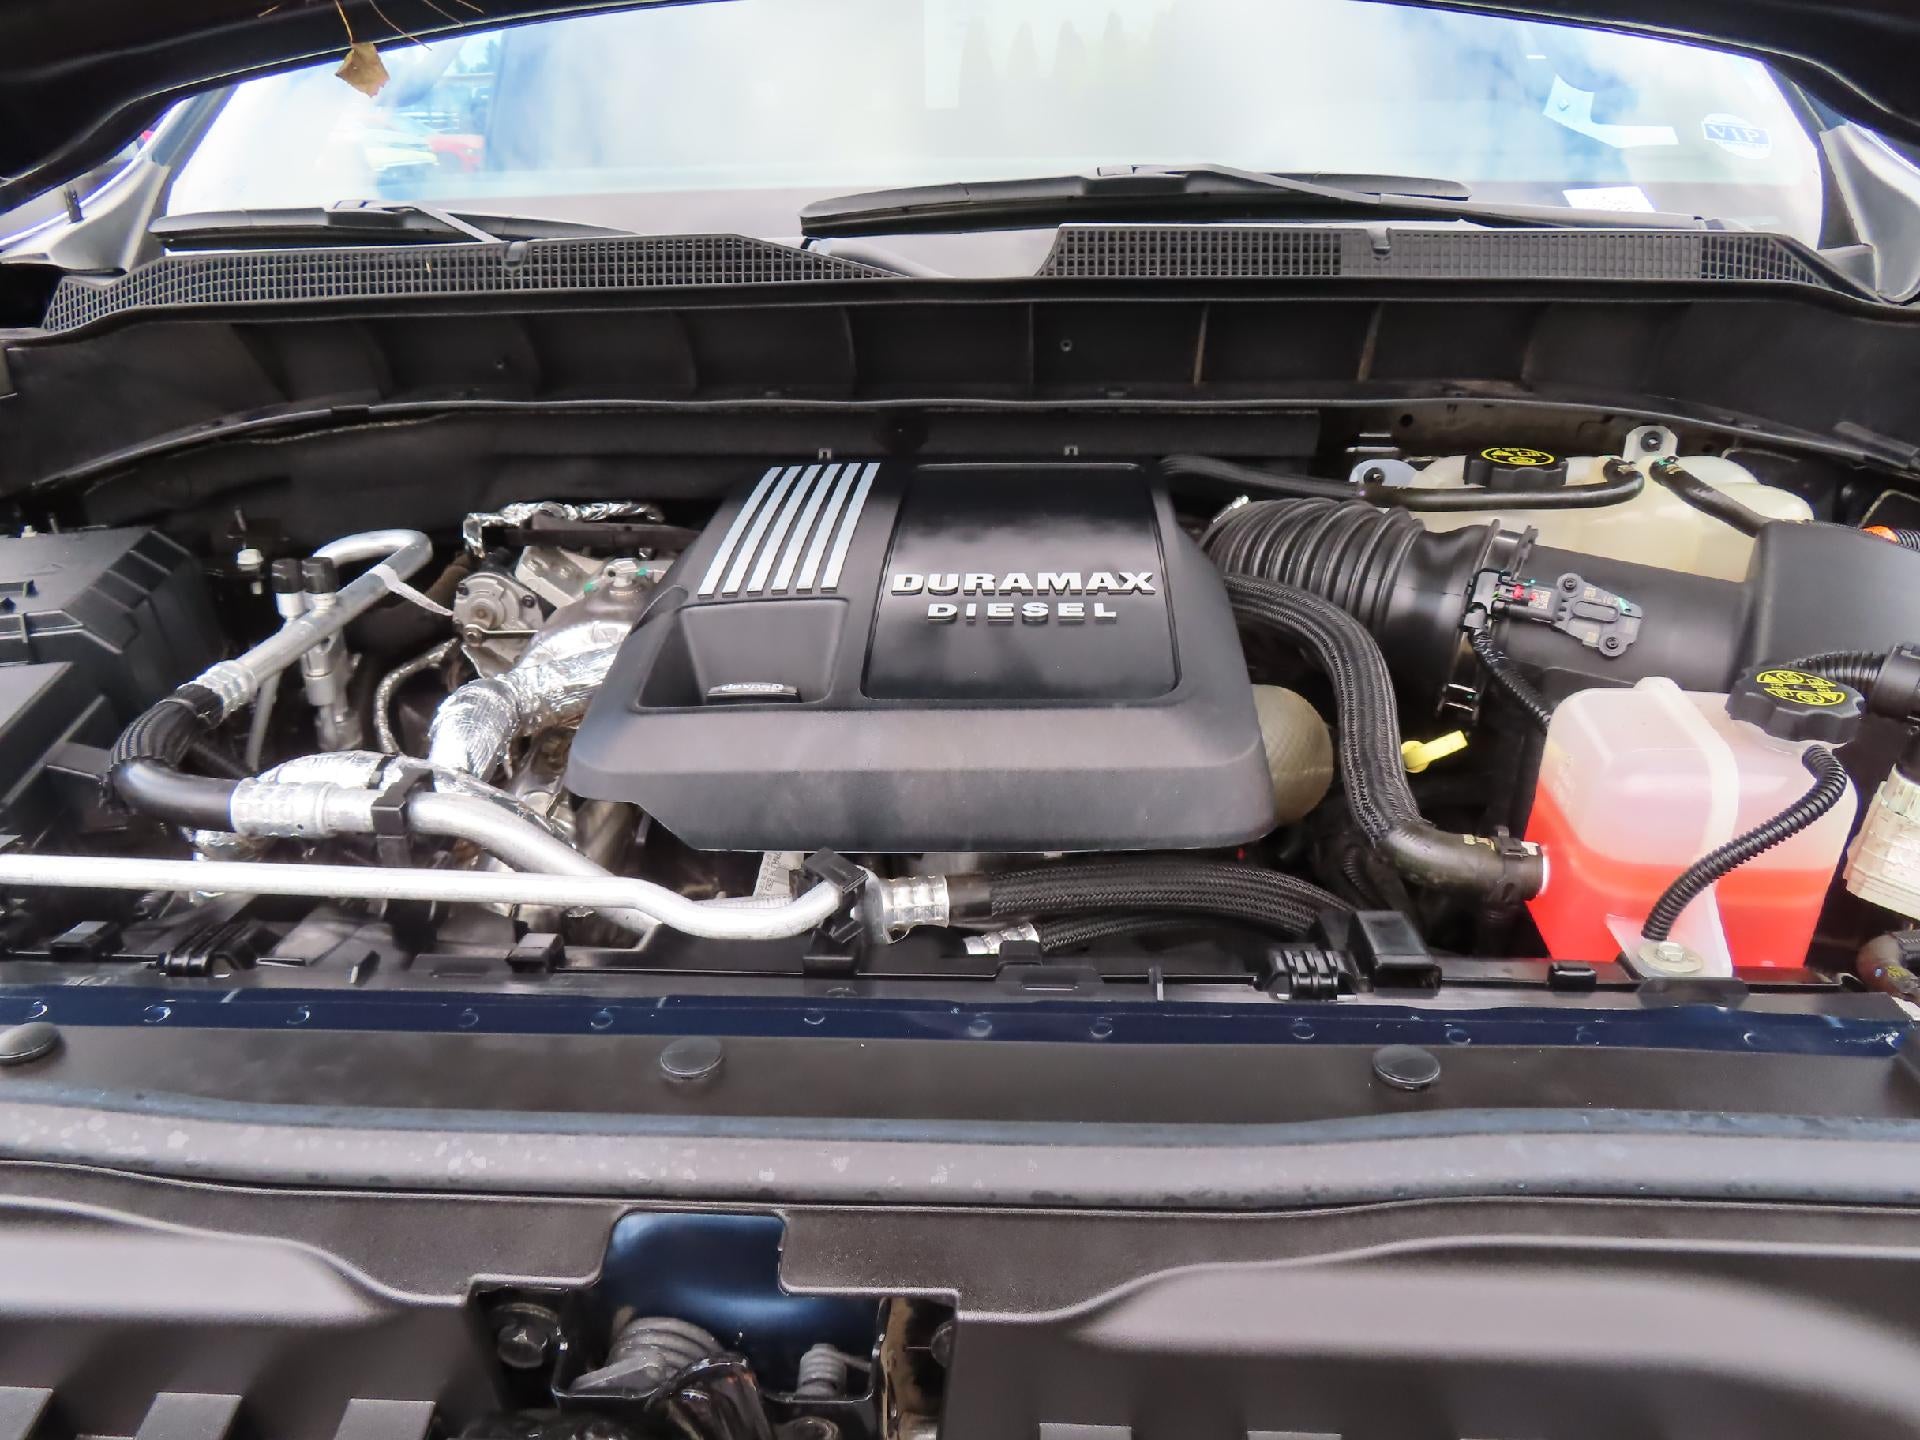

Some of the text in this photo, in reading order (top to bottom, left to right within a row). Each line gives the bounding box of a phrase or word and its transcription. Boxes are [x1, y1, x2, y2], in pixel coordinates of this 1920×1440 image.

[1705, 125, 1761, 142] VIP
[891, 572, 1156, 595] DURAMAX
[927, 601, 1117, 624] DIESEL
